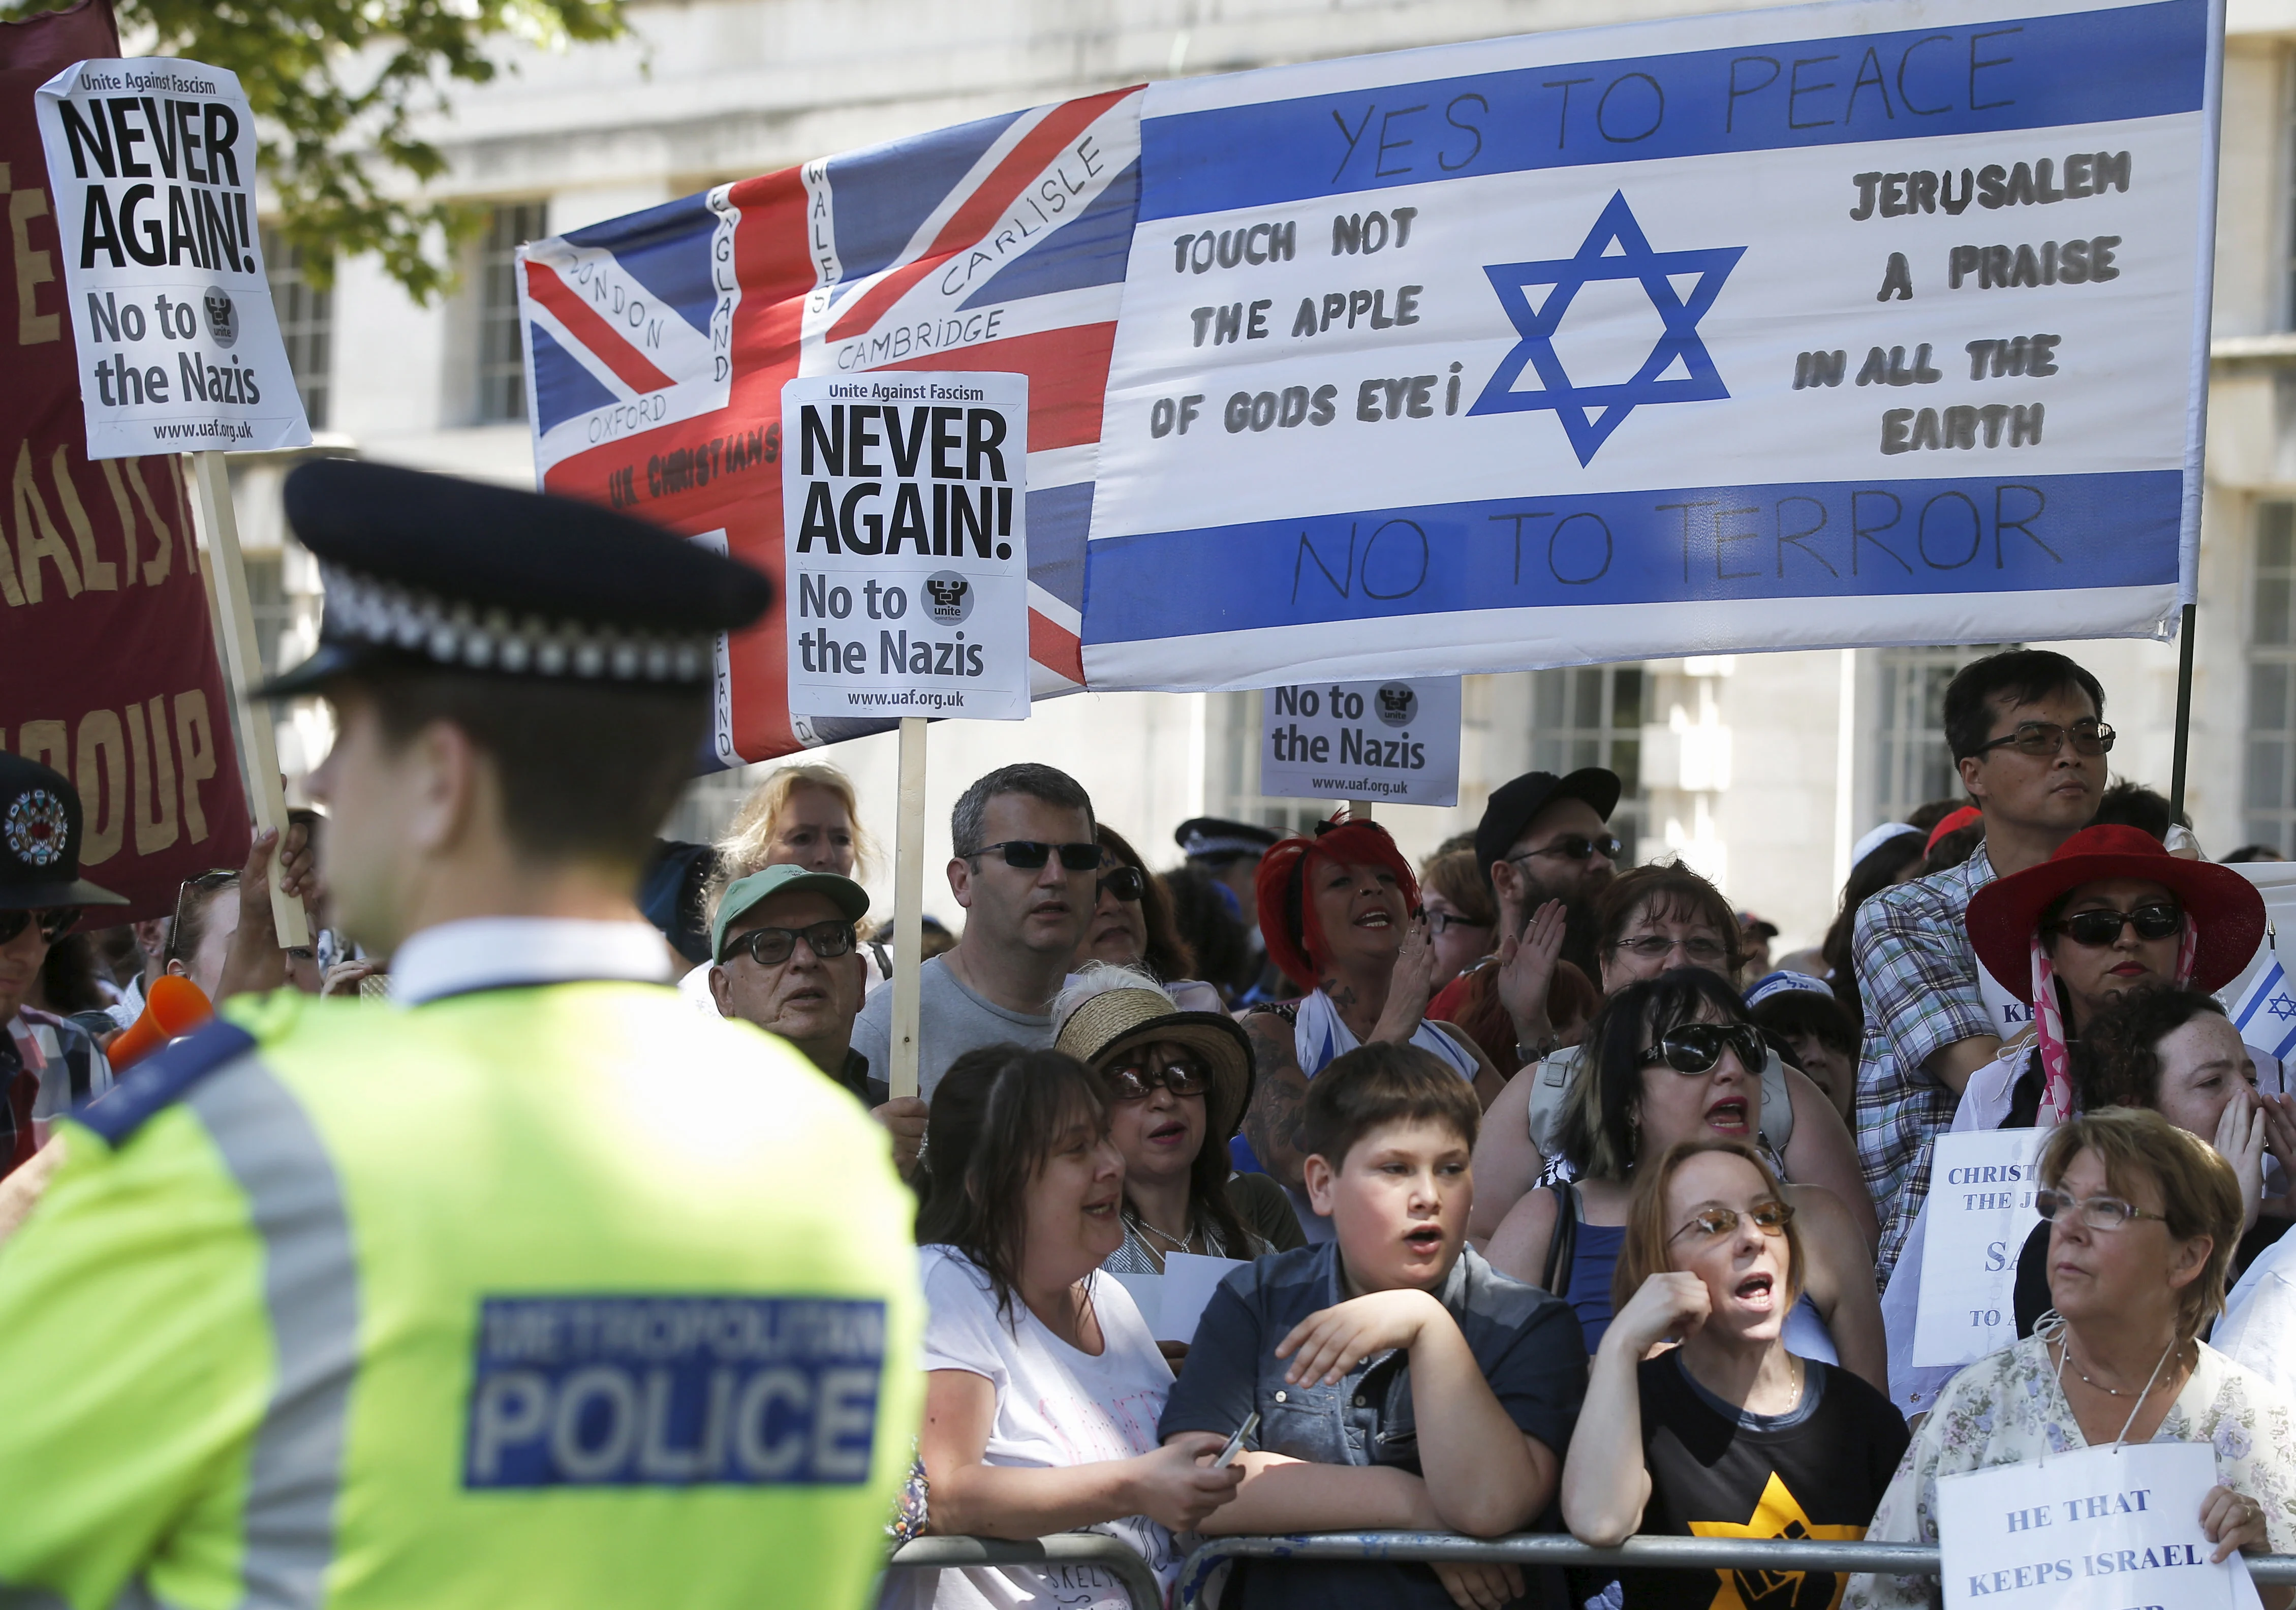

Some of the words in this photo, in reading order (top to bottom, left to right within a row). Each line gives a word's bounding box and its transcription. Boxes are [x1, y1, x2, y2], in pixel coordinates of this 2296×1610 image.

[81, 74, 121, 90] Unite
[126, 73, 171, 92] Against
[172, 75, 216, 95] Fascism
[1331, 92, 1489, 184] YES
[1542, 72, 1664, 150] TO
[1726, 27, 2024, 133] PEACE
[58, 97, 240, 186] NEVER
[1850, 151, 2131, 221] JERUSALEM
[80, 183, 256, 274] AGAIN!
[809, 164, 834, 313] WALES
[942, 136, 1103, 296] CARLISLE
[1174, 221, 1296, 274] TOUCH
[1331, 206, 1418, 257] NOT
[711, 193, 737, 382] ENGLAND
[1876, 252, 1913, 301] A
[1947, 235, 2122, 290] PRAISE
[87, 292, 146, 343] No
[156, 294, 196, 340] to
[837, 309, 1004, 369] CAMBRIDGE
[1191, 299, 1272, 348] THE
[1291, 285, 1423, 339] APPLE
[95, 353, 168, 407] the
[179, 351, 260, 405] Nazis
[1791, 349, 1847, 390] IN
[1855, 343, 1942, 387] ALL
[1965, 333, 2061, 381] THE
[588, 395, 666, 444] OXFORD
[829, 384, 867, 398] Unite
[872, 383, 926, 402] Against
[930, 384, 984, 401] Fascism
[1151, 394, 1205, 440] OF
[1224, 384, 1338, 434] GODS
[153, 418, 253, 443] www.uaf.org.uk
[801, 405, 1007, 481] NEVER
[1879, 401, 2044, 455] EARTH
[609, 465, 639, 508] UK
[647, 422, 780, 498] CHRISTIANS
[796, 481, 1013, 561] AGAIN!
[1291, 518, 1429, 605] NO
[1489, 510, 1614, 584] TO
[1656, 484, 2062, 584] TERROR
[800, 573, 852, 619] No
[863, 578, 907, 619] to
[935, 606, 960, 615] unite
[798, 628, 866, 674] the
[880, 630, 983, 676] Nazis
[848, 688, 964, 709] www.uaf.org.uk
[1275, 685, 1320, 717] No
[1328, 685, 1364, 720] to
[1385, 711, 1406, 720] unite
[1271, 724, 1329, 763] the
[1340, 727, 1425, 769] Nazis
[1312, 778, 1408, 795] www.uaf.org.uk
[1963, 1192, 2011, 1211] THE
[1969, 1310, 2001, 1326] TO
[470, 1366, 874, 1481] POLICE
[2006, 1505, 2052, 1533] HE
[2063, 1489, 2151, 1522] THAT
[1968, 1559, 2073, 1597] KEEPS
[2084, 1544, 2203, 1576] ISRAEL
